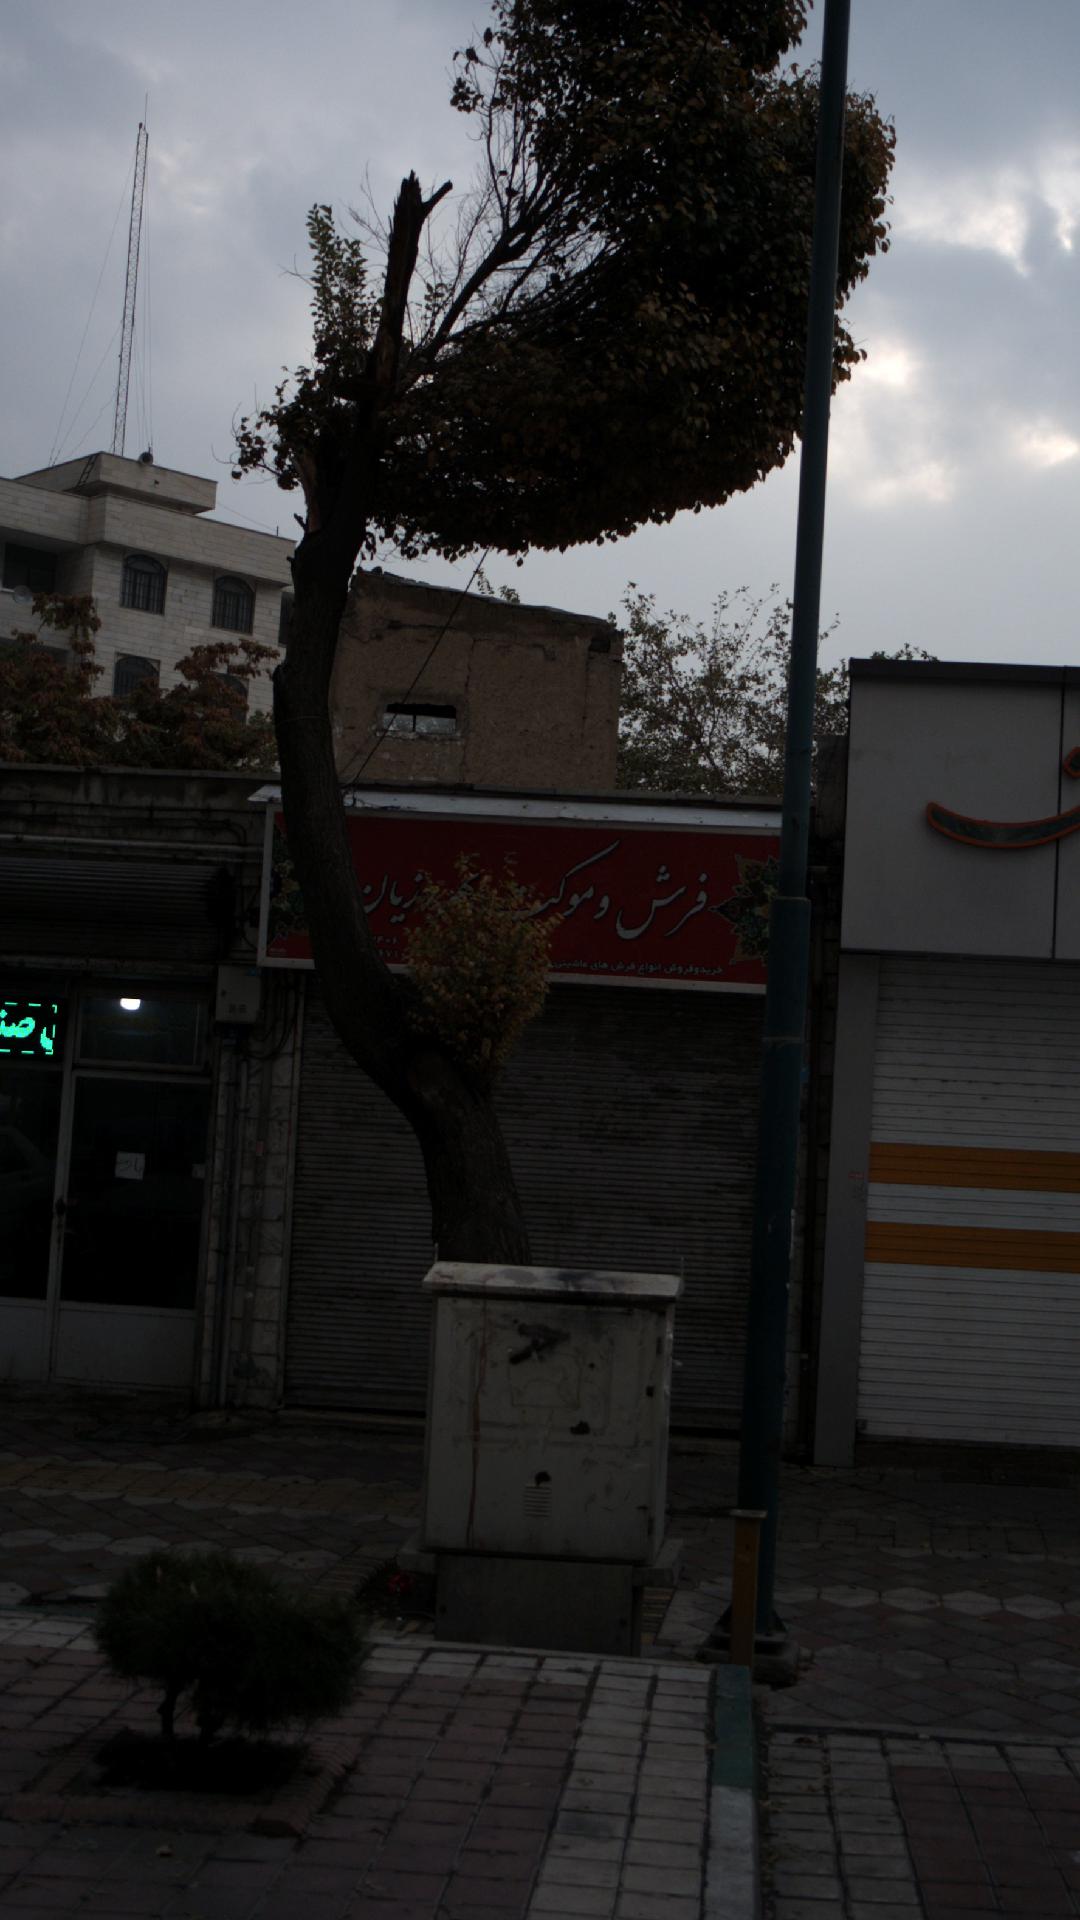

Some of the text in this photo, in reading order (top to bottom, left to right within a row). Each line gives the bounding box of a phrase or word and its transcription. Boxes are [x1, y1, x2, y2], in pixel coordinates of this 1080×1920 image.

[593, 890, 610, 920] و
[615, 864, 708, 940] فرش
[608, 960, 636, 973] فرش
